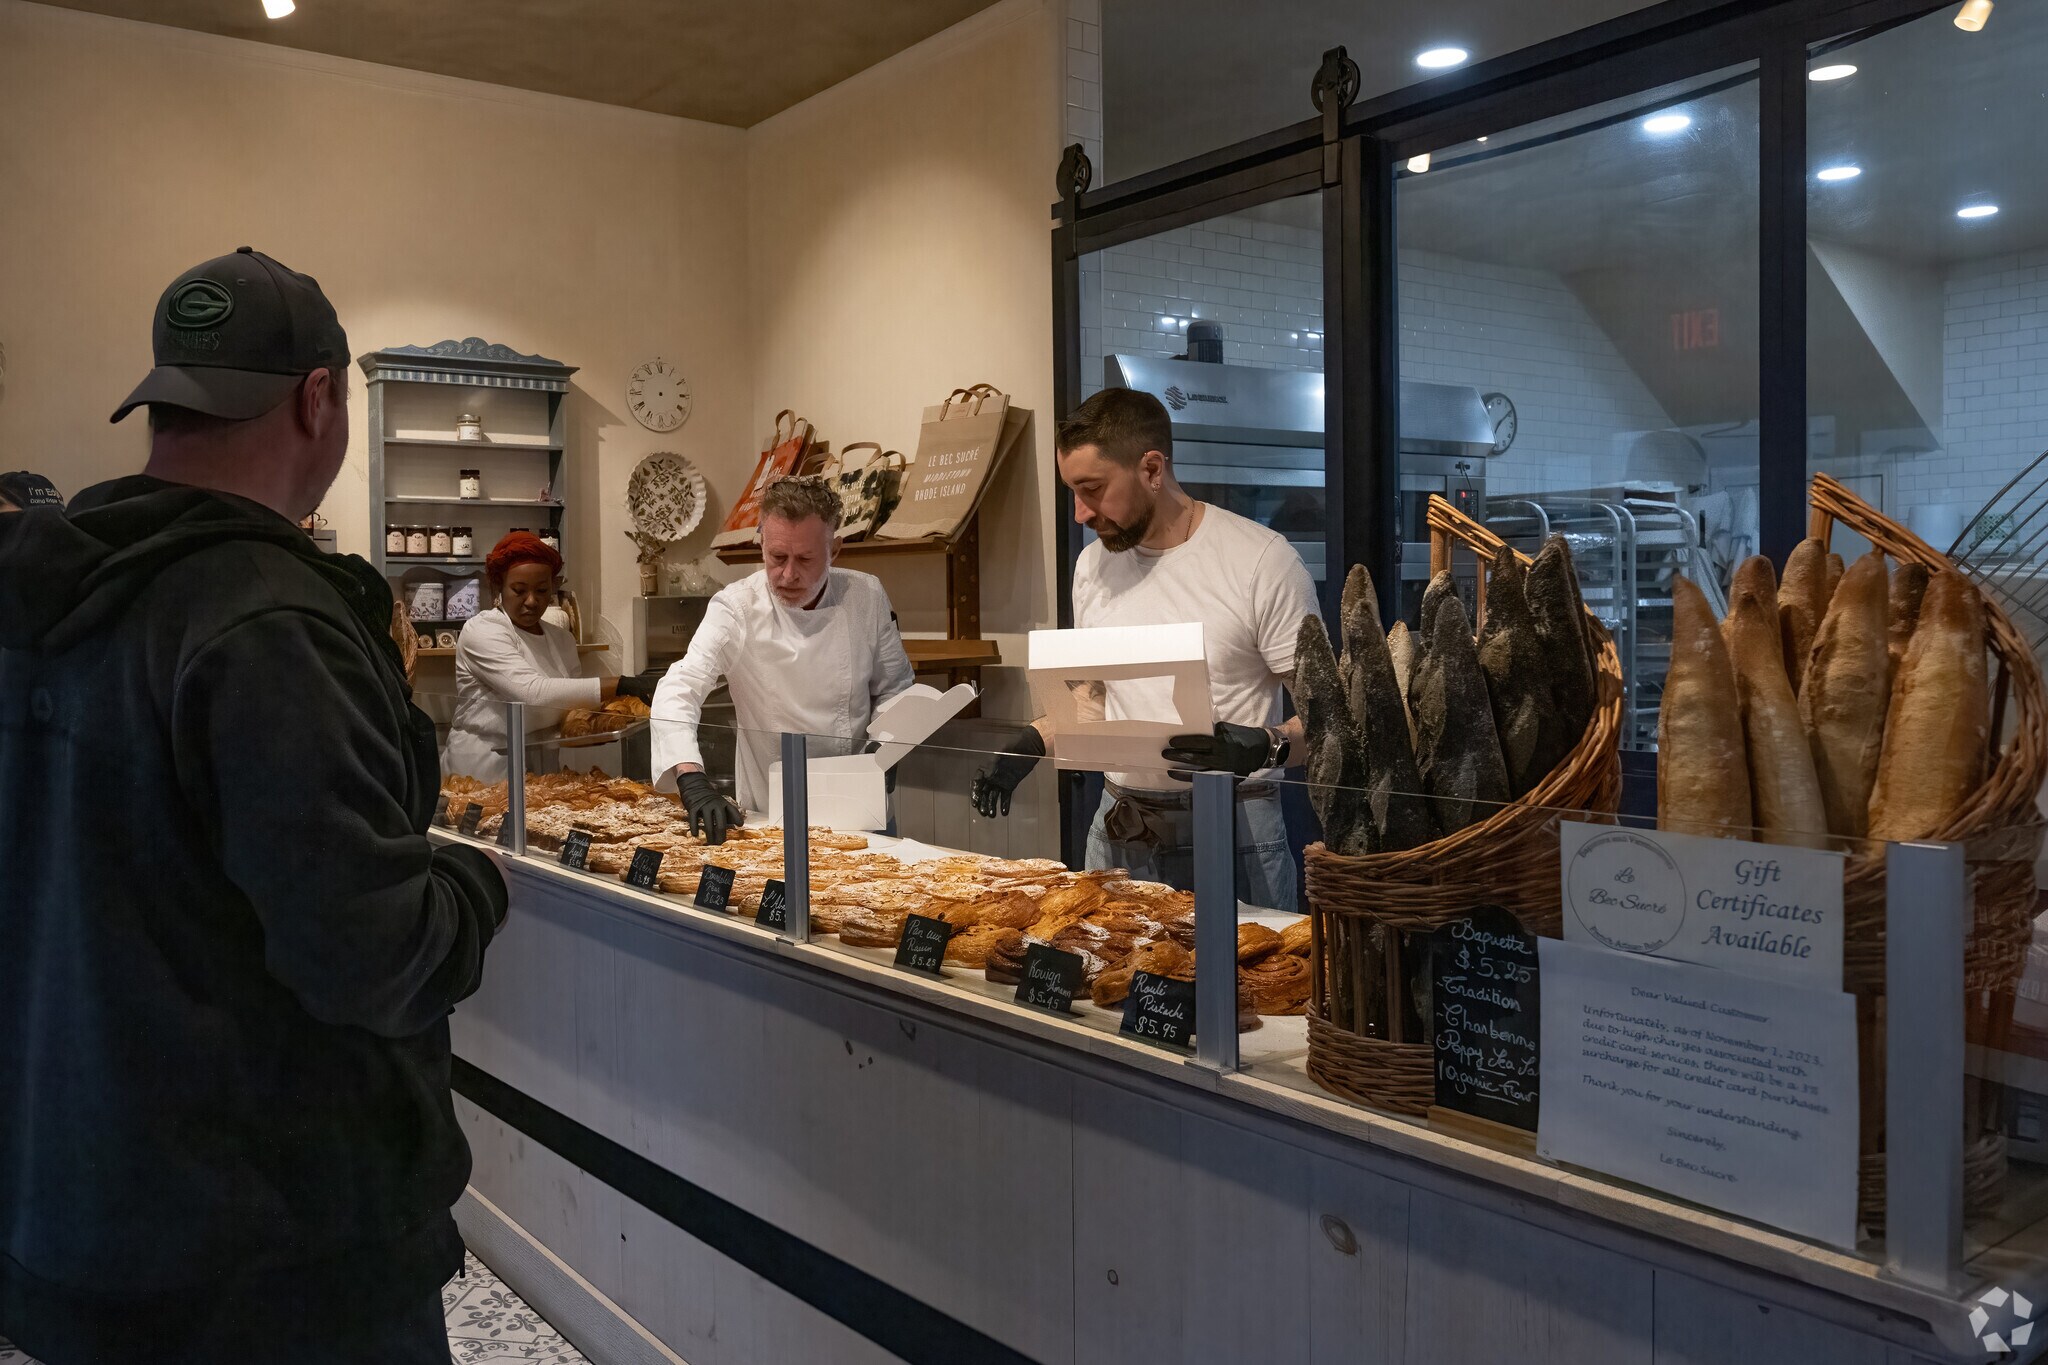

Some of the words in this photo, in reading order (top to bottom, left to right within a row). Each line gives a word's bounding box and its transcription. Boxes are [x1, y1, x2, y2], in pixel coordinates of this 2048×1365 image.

[928, 456, 937, 468] LE
[939, 453, 954, 466] BEC
[956, 446, 980, 464] SUCRÉ
[940, 482, 967, 498] ISLAND
[1734, 859, 1781, 887] Gift
[1696, 889, 1824, 925] Certificates
[1700, 925, 1812, 959] Available
[1134, 973, 1169, 996] Roulé
[1632, 987, 1660, 999] Dear
[1134, 1015, 1178, 1039] $5.95
[1582, 1035, 1618, 1049] credit
[1619, 1044, 1648, 1056] card
[1582, 1018, 1605, 1031] due
[1777, 1065, 1808, 1078] with
[1706, 1031, 1769, 1053] November
[1642, 1060, 1662, 1073] for
[1663, 1066, 1681, 1079] all
[1726, 1081, 1759, 1097] card
[1583, 1074, 1620, 1091] Thank
[1620, 1087, 1645, 1099] you
[1645, 1089, 1663, 1102] for
[1663, 1099, 1695, 1111] your
[1660, 1153, 1674, 1165] Le
[1676, 1158, 1699, 1173] Bec
